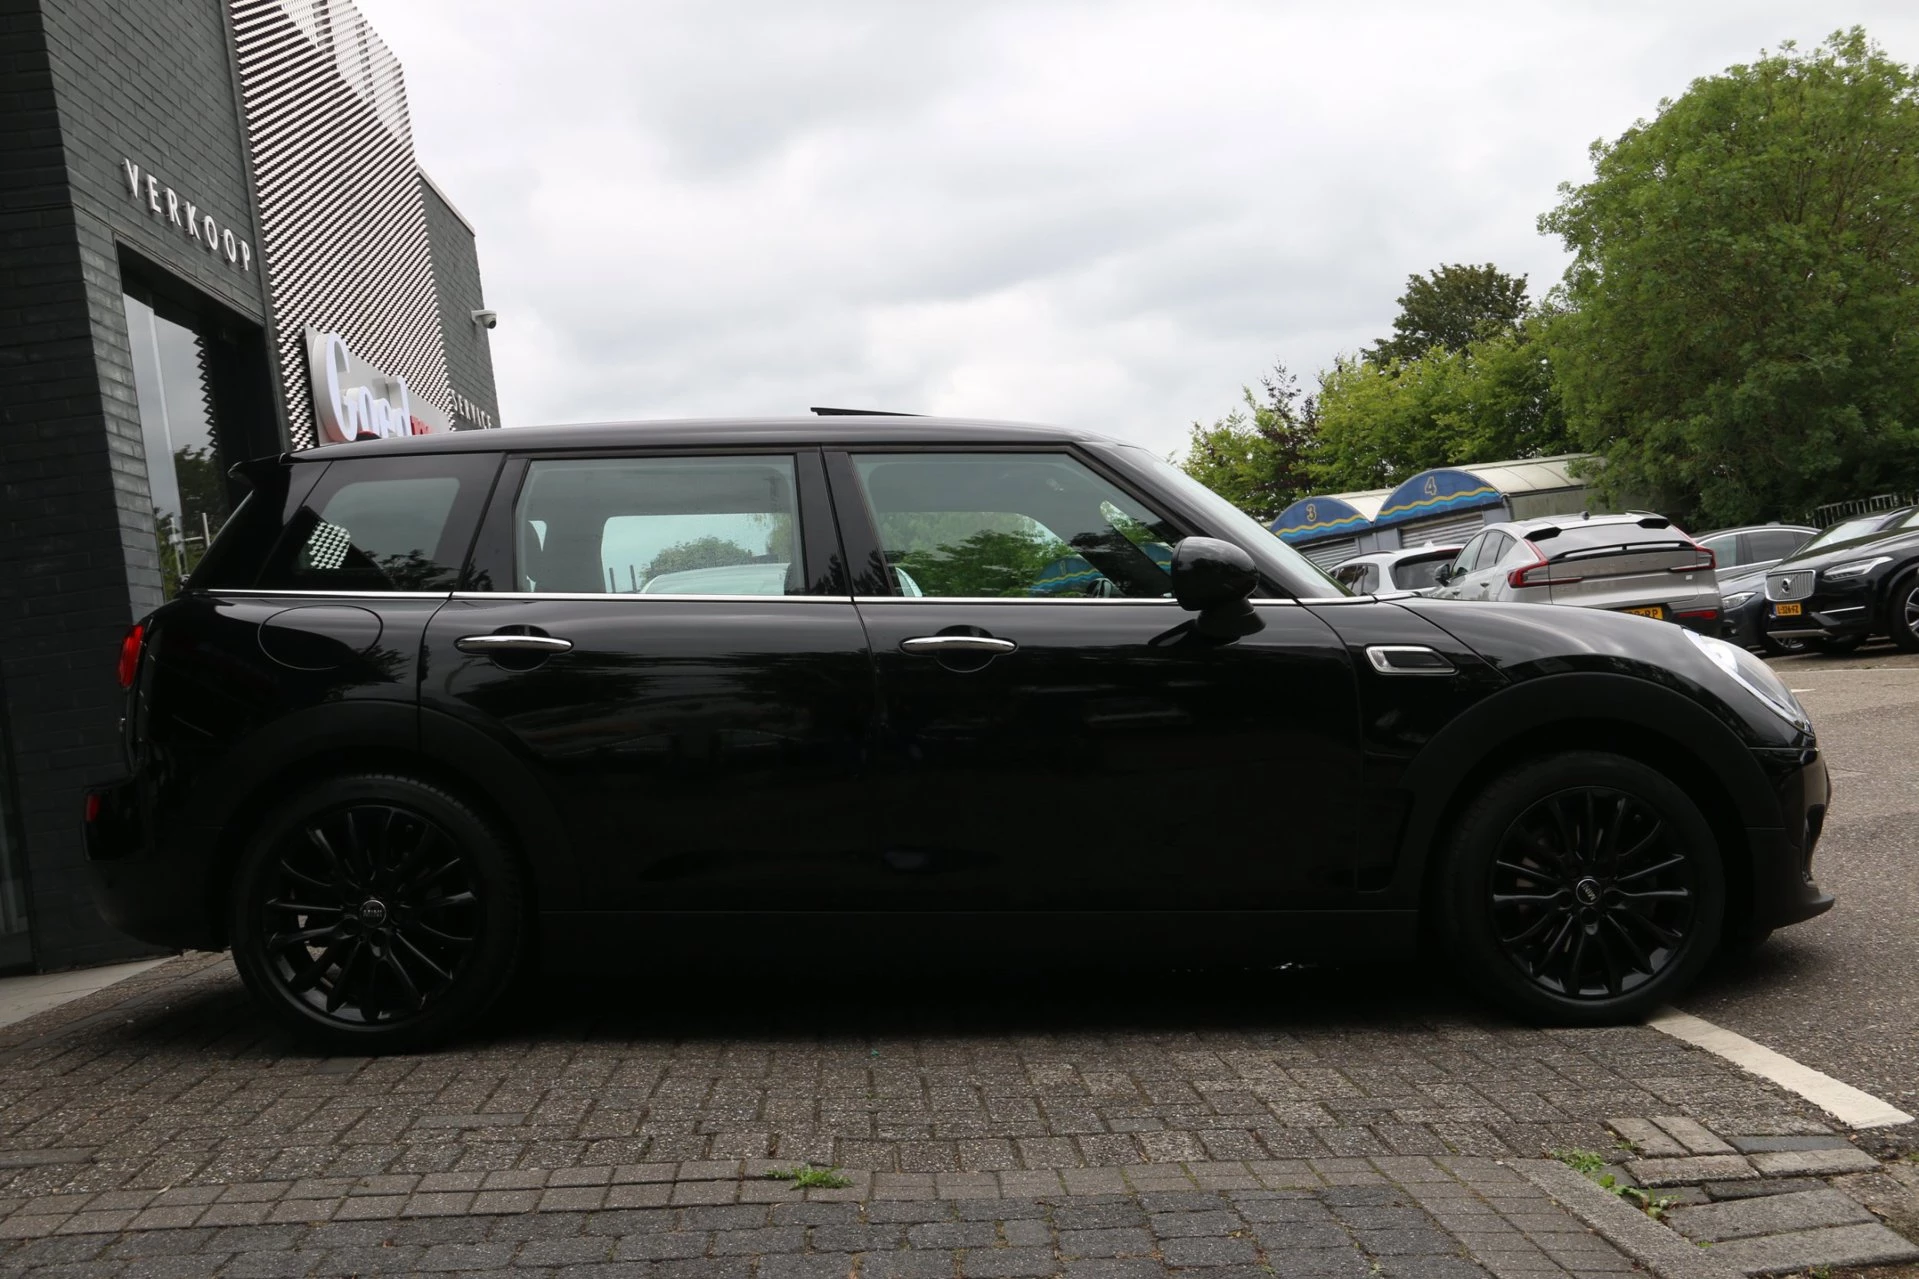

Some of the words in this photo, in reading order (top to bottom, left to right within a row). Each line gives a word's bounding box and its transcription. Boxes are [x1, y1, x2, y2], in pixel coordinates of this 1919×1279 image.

[124, 158, 250, 271] VERKOOP
[451, 389, 492, 430] SERVICE
[1424, 476, 1437, 496] 4
[1306, 503, 1317, 522] 3
